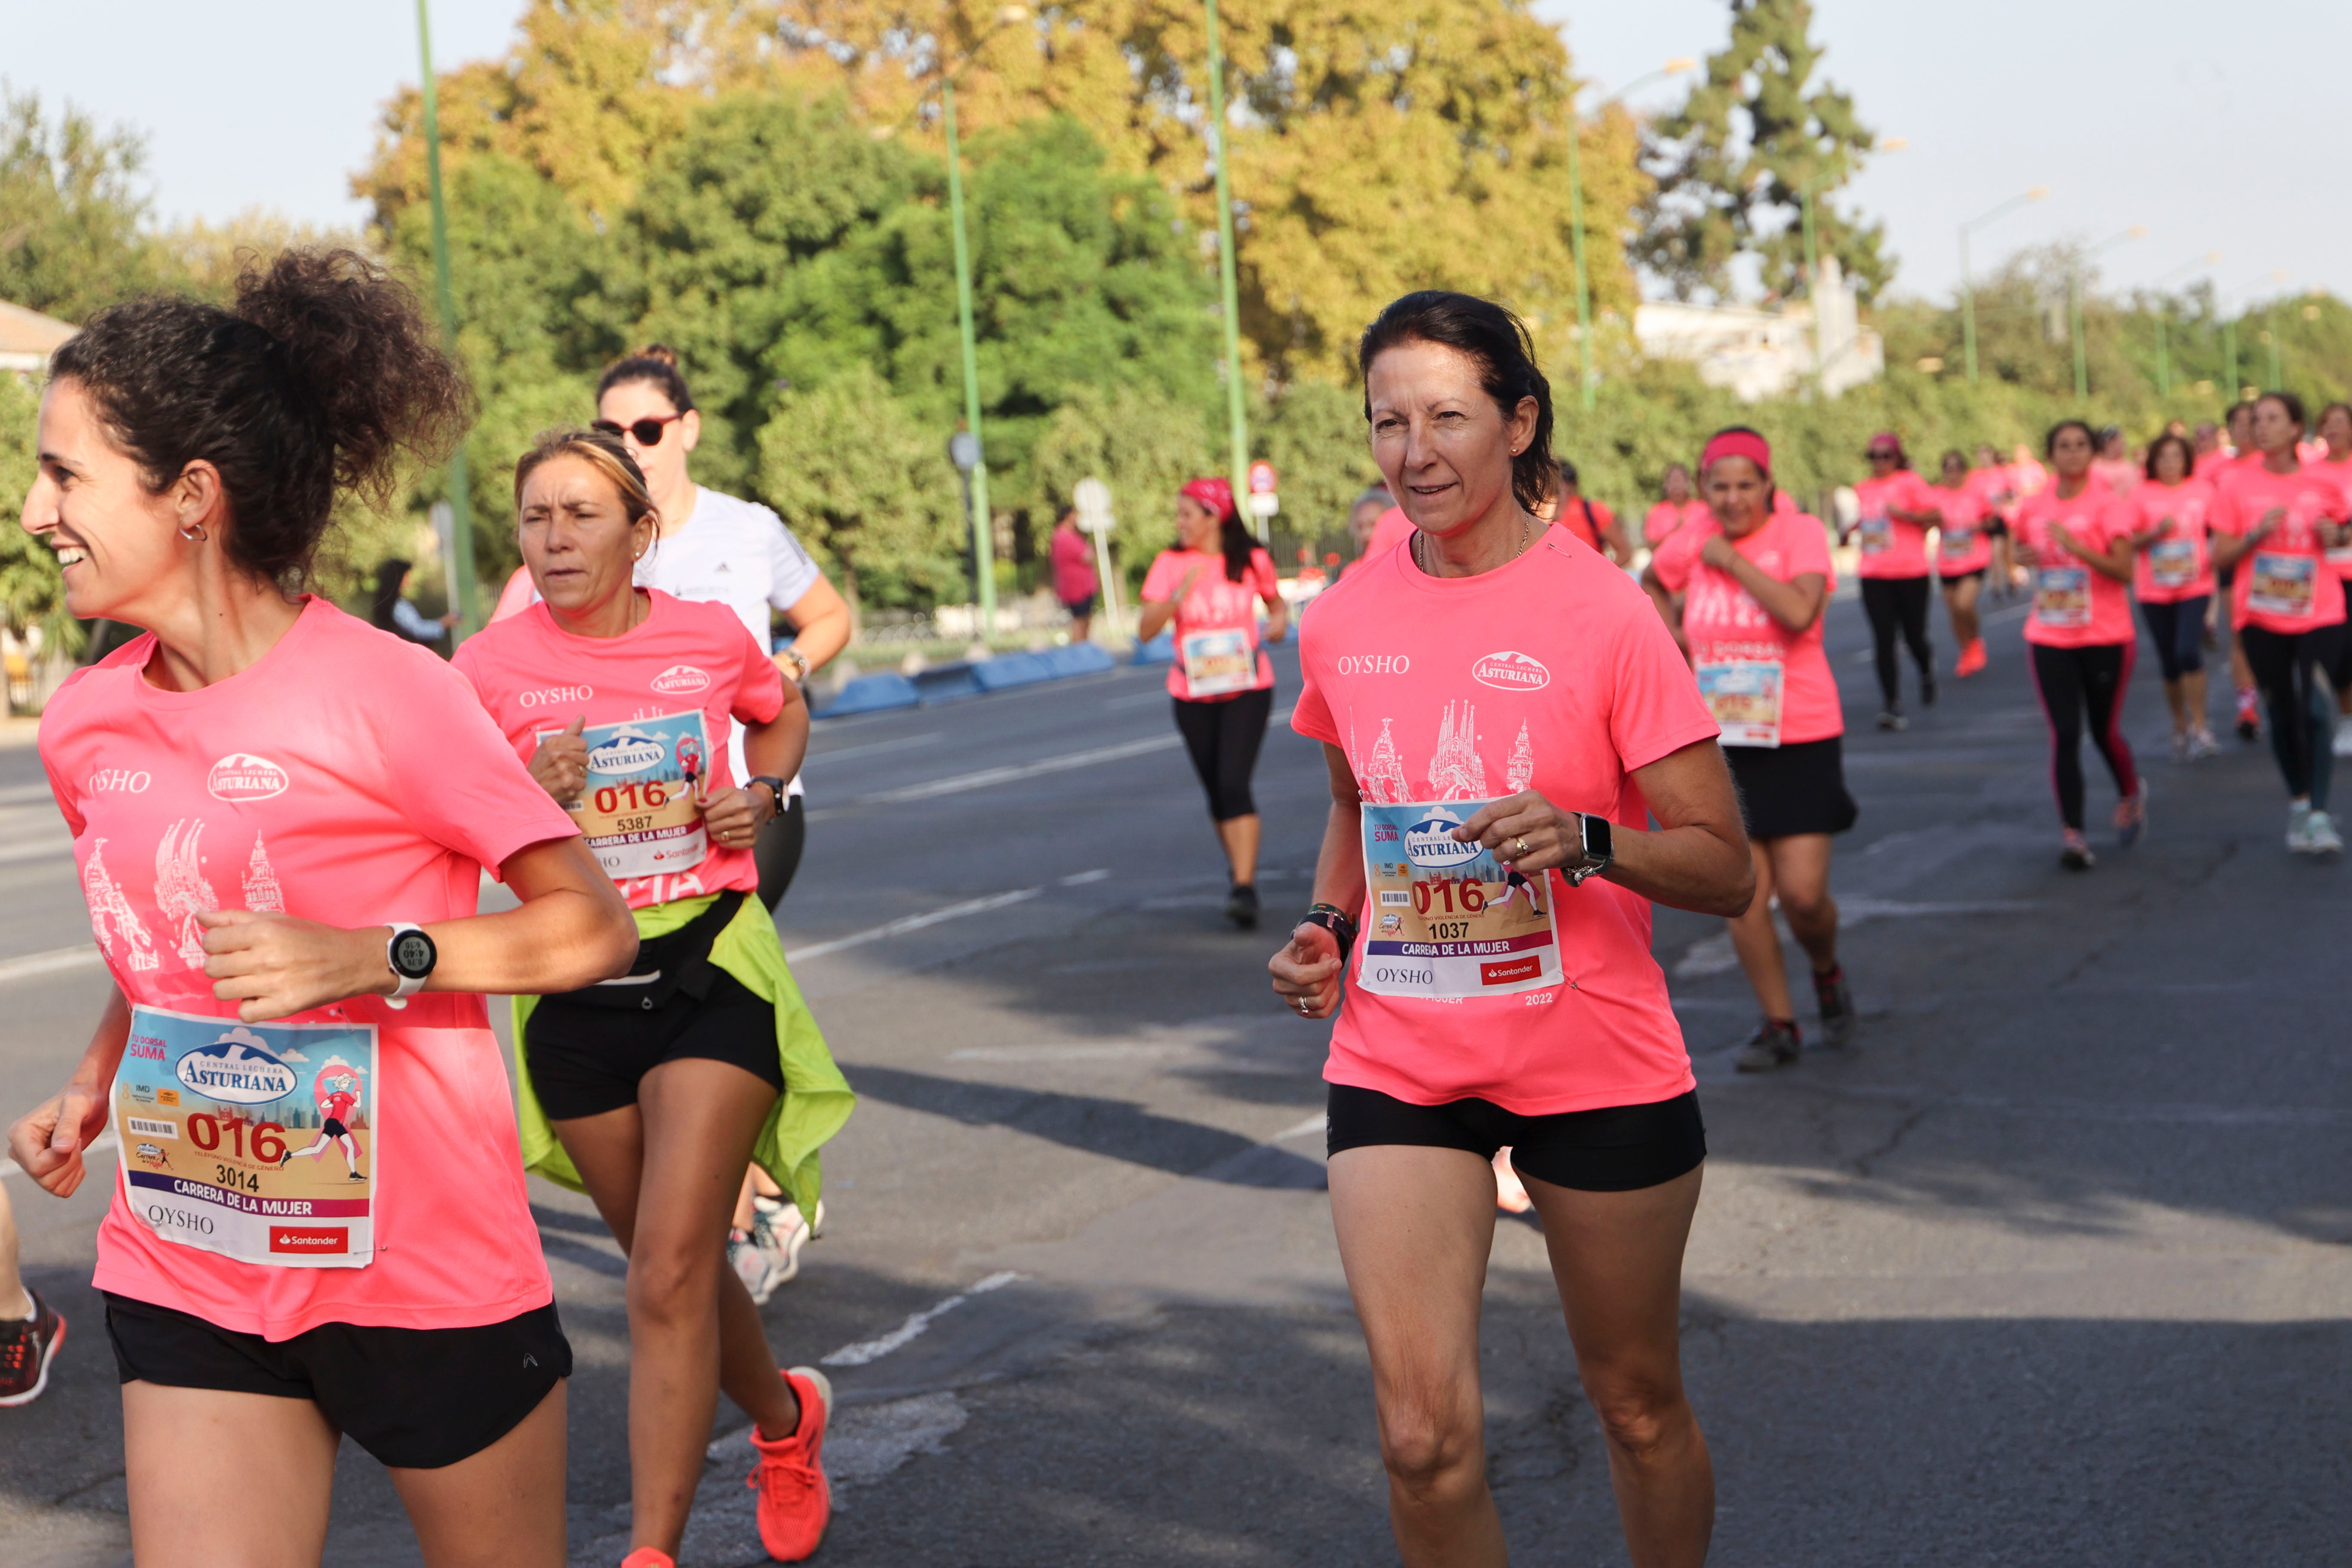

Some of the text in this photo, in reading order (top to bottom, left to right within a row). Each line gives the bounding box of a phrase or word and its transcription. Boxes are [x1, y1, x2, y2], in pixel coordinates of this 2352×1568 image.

[1338, 655, 1410, 674] OYSHO
[1477, 663, 1543, 685] ASTURIANA
[520, 685, 593, 708] OYSHO
[591, 750, 660, 769] ASTURIANA
[212, 773, 280, 791] ASTURIANA
[595, 780, 666, 813] 016
[618, 816, 652, 832] 5387
[628, 833, 640, 843] DE
[643, 830, 655, 842] LA
[656, 826, 687, 839] MUJER
[1375, 831, 1399, 842] SUMA
[1408, 838, 1479, 857] ASTURIANA
[1412, 878, 1485, 915] 016
[1429, 922, 1469, 939] 1037
[1402, 941, 1510, 956] CARRERA DE LA MUJER
[1377, 968, 1433, 984] OYSHO
[1498, 965, 1532, 977] Santander
[1525, 992, 1553, 1006] 2022
[132, 1034, 167, 1047] TU DORSAL
[130, 1044, 165, 1061] SUMA
[184, 1060, 287, 1091] ASTURIANA
[200, 1060, 283, 1074] CENTRAL LECHERA
[136, 1084, 150, 1093] IMD
[187, 1112, 287, 1163] 016
[216, 1164, 259, 1192] 3014
[174, 1179, 312, 1215] CARRERA DE LA MUJER
[149, 1205, 214, 1234] OYSHO
[291, 1236, 338, 1245] Santander
